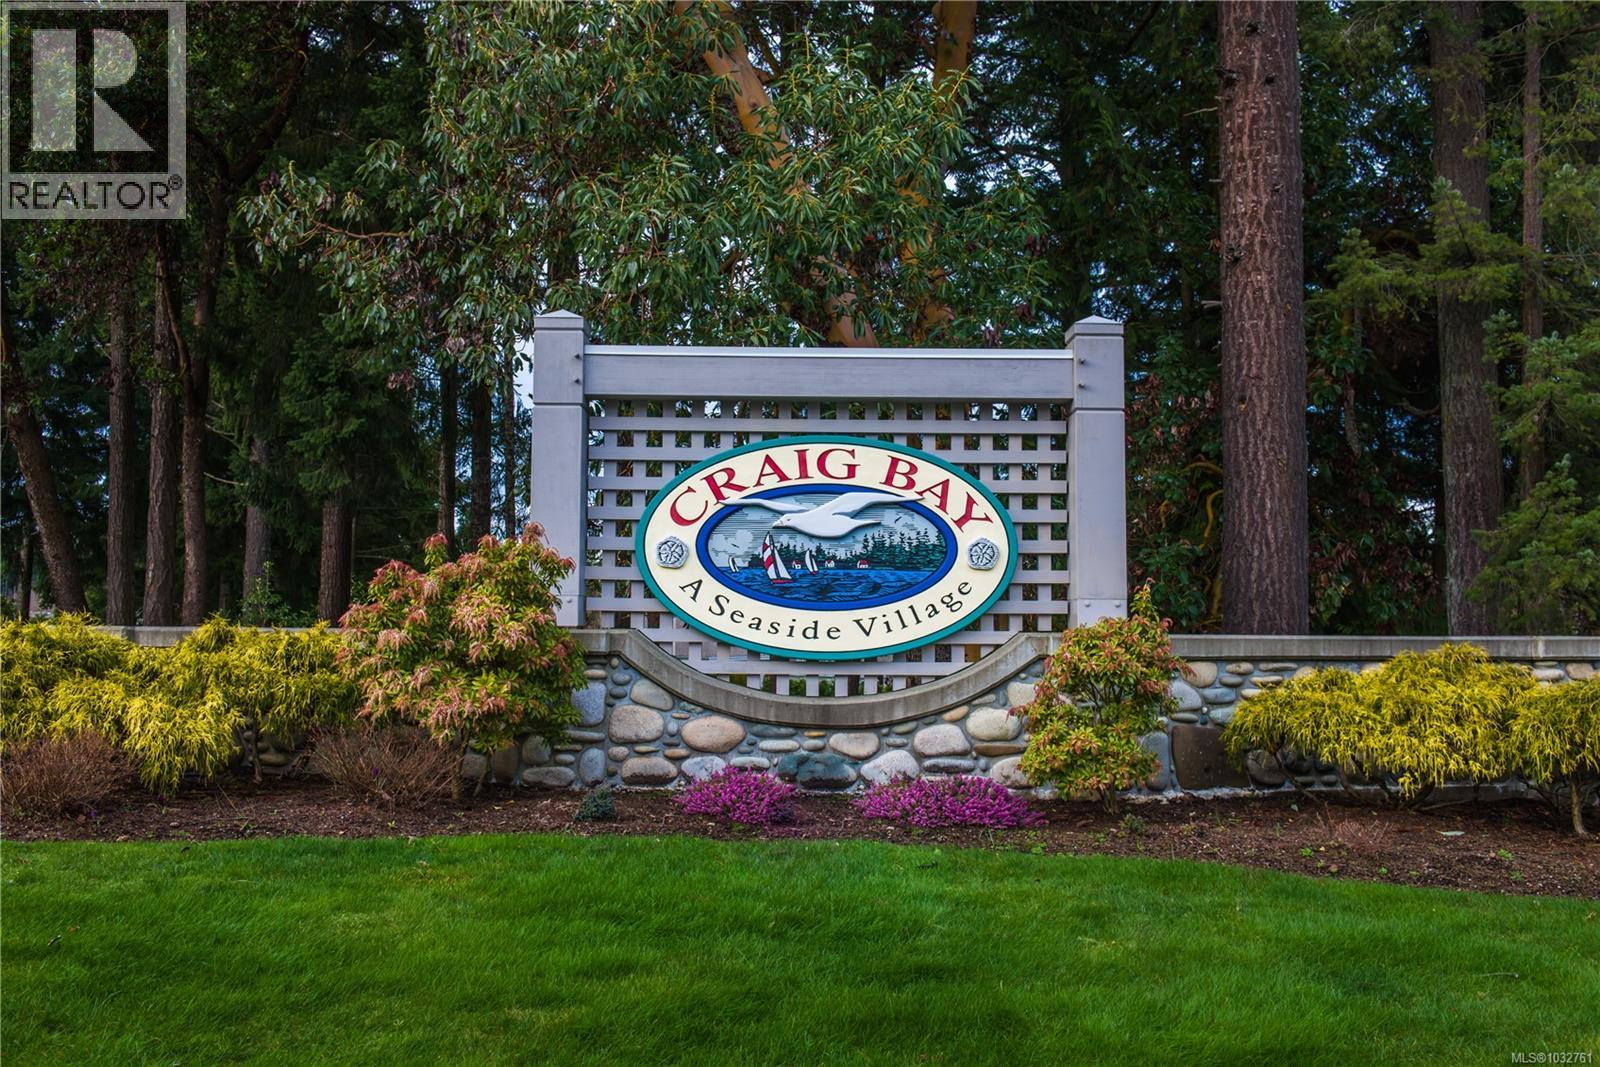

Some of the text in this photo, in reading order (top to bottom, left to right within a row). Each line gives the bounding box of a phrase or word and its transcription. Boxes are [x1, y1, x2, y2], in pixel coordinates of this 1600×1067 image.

[669, 447, 994, 533] CRAIG BAY
[678, 578, 973, 640] A Seaside Village
